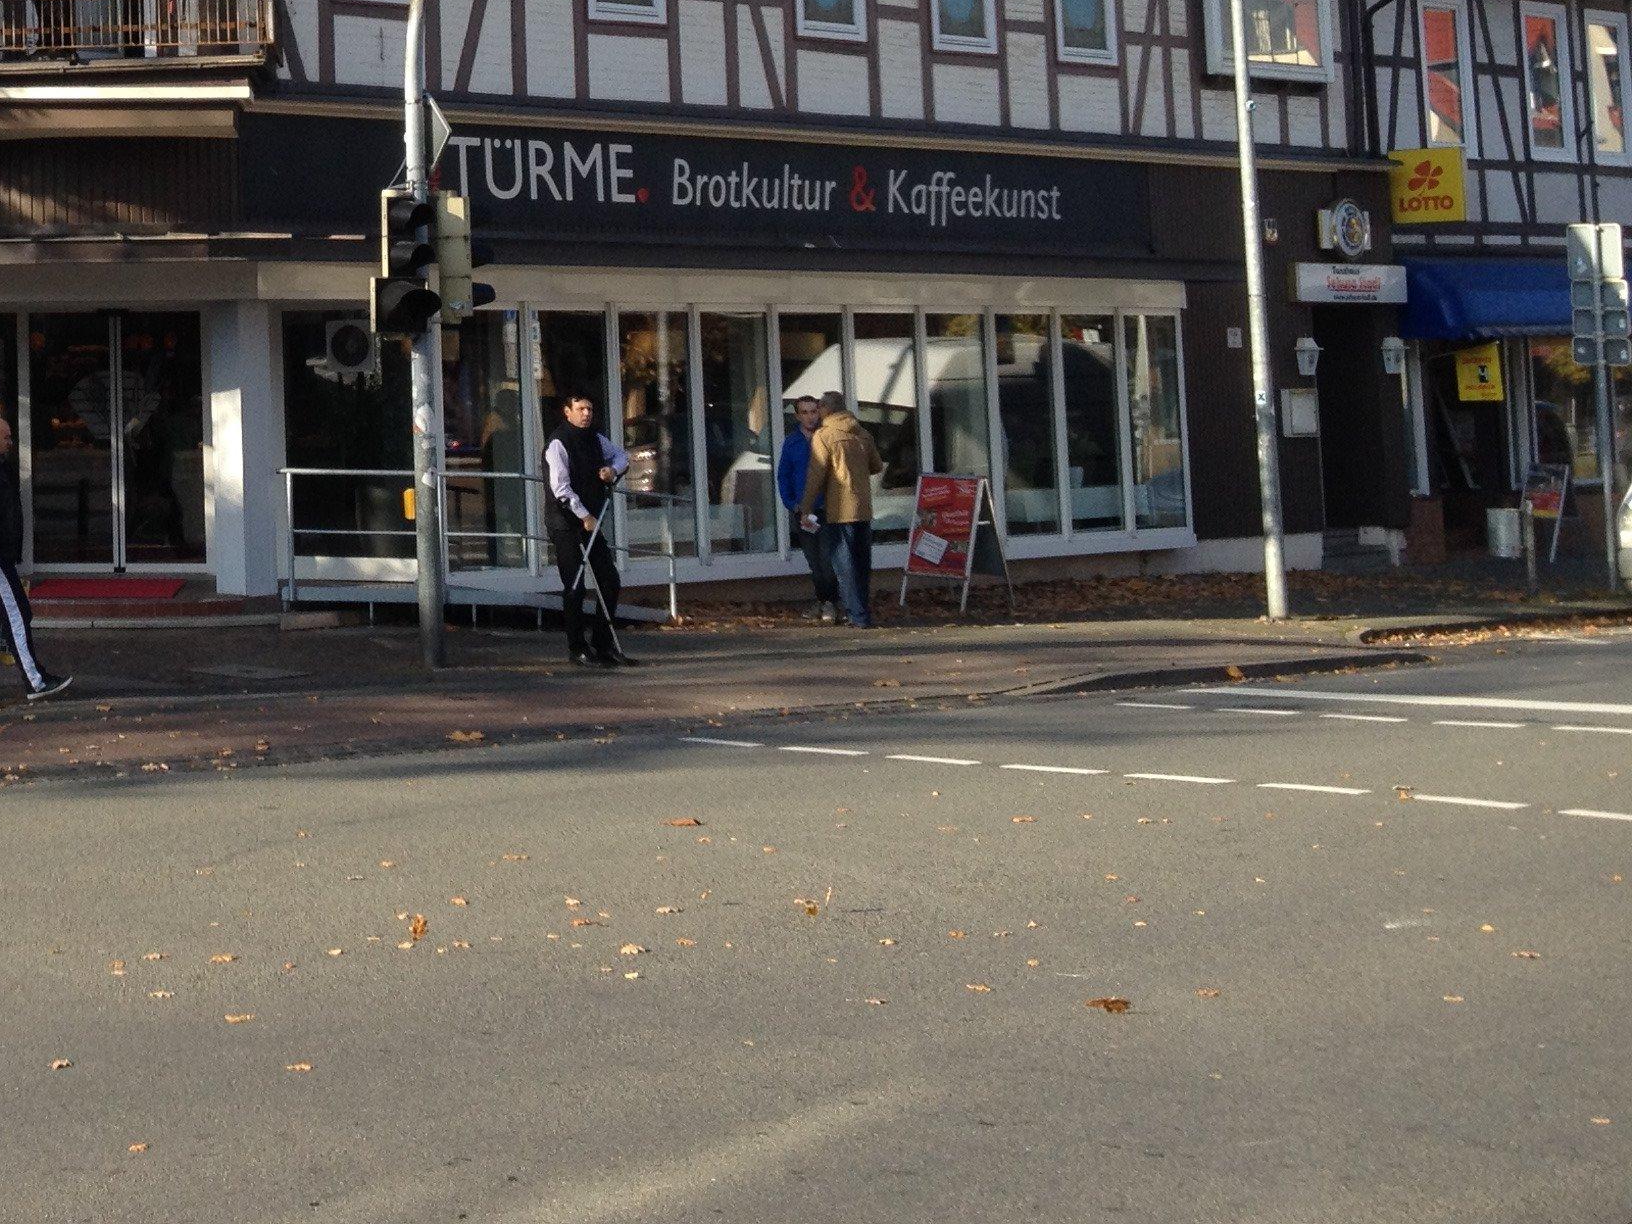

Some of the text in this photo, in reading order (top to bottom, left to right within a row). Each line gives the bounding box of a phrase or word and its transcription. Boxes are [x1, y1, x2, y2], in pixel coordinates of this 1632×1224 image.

[429, 136, 1062, 227] TÜRME. Brotkultur & Kaffeekunst
[1398, 194, 1454, 213] LOTTO
